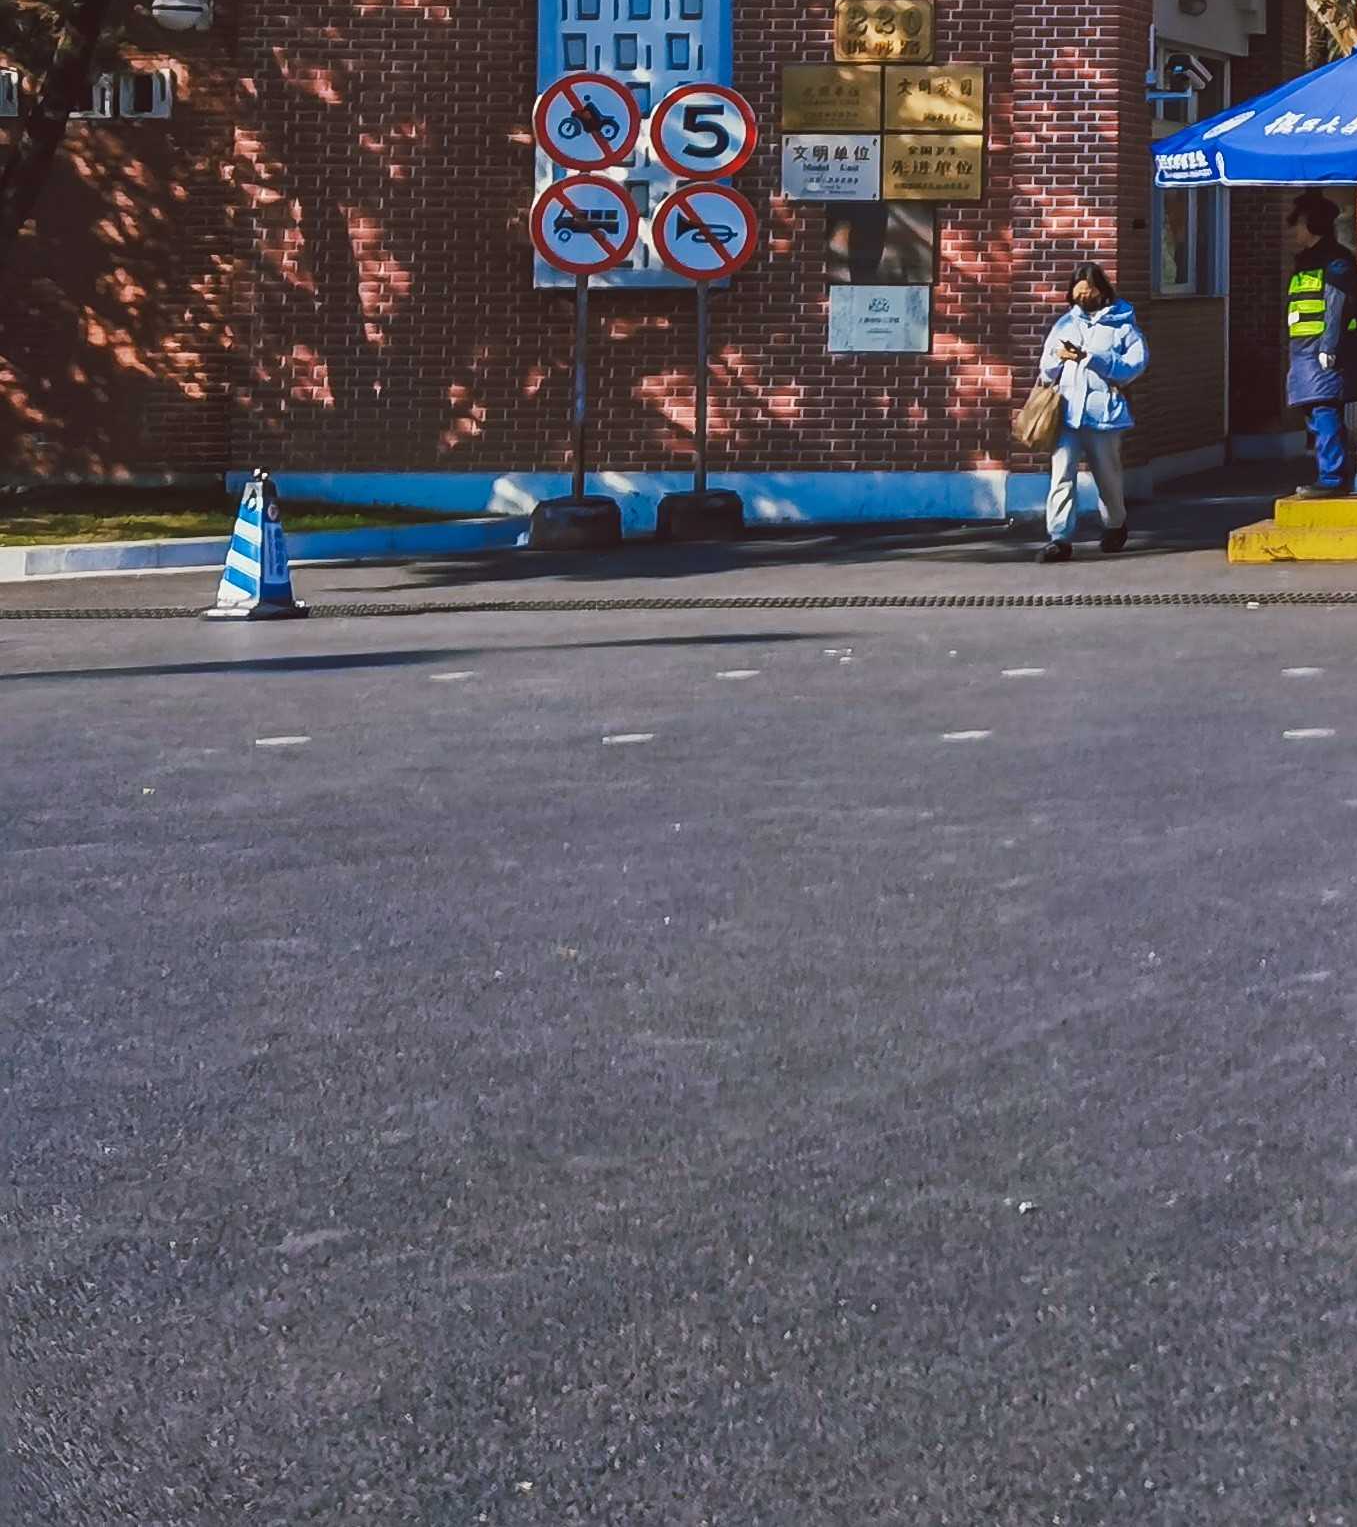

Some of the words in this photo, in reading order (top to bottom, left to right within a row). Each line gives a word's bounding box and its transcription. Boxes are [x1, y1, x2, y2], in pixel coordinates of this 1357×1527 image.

[846, 4, 923, 36] 220
[682, 104, 730, 159] 5
[793, 145, 870, 162] 文明单位
